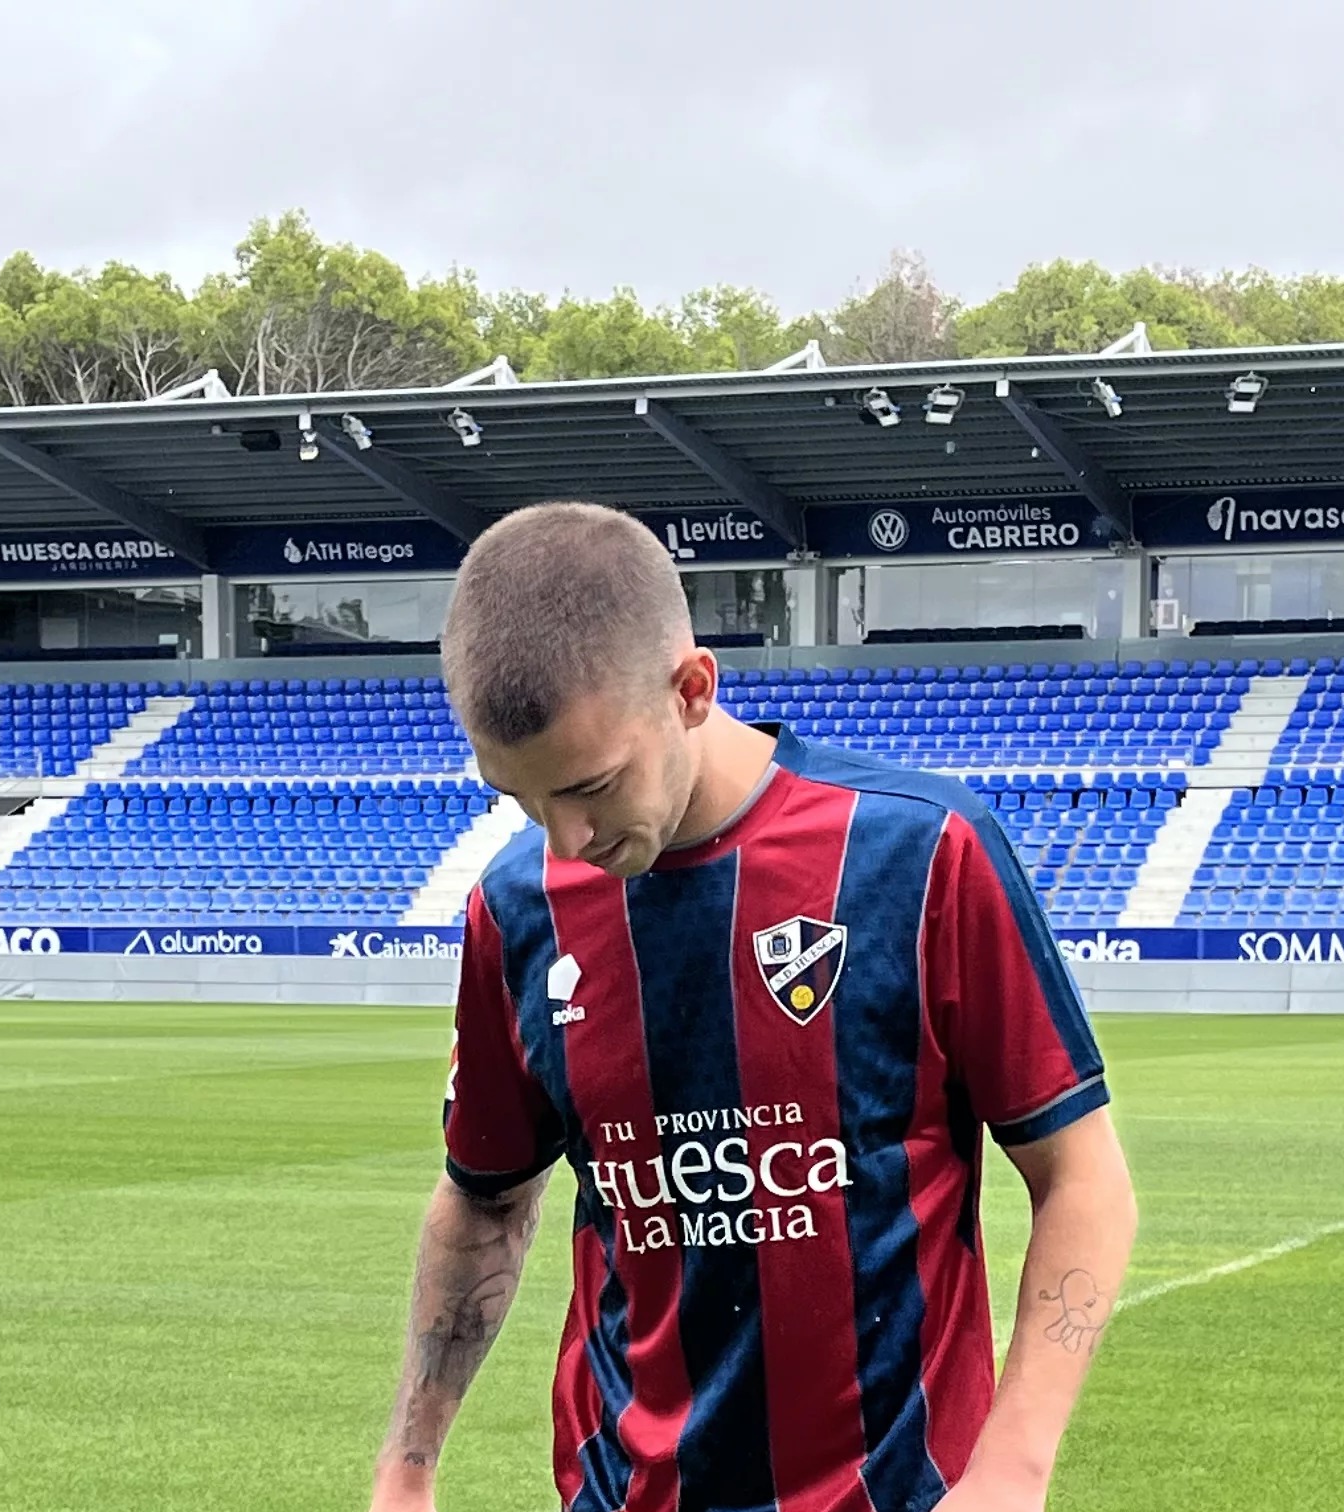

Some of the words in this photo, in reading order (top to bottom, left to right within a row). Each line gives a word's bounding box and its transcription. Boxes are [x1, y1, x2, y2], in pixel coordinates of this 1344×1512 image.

[931, 504, 1052, 525] Automóviles
[681, 512, 765, 542] levitec
[947, 523, 1080, 549] CABRERO
[0, 542, 93, 562] HUESCA
[94, 541, 175, 559] GARDE
[305, 541, 342, 562] ATH
[347, 542, 414, 563] Riegos
[159, 930, 263, 953] alumbra
[363, 932, 464, 960] CaixaBan
[552, 1003, 586, 1025] soka
